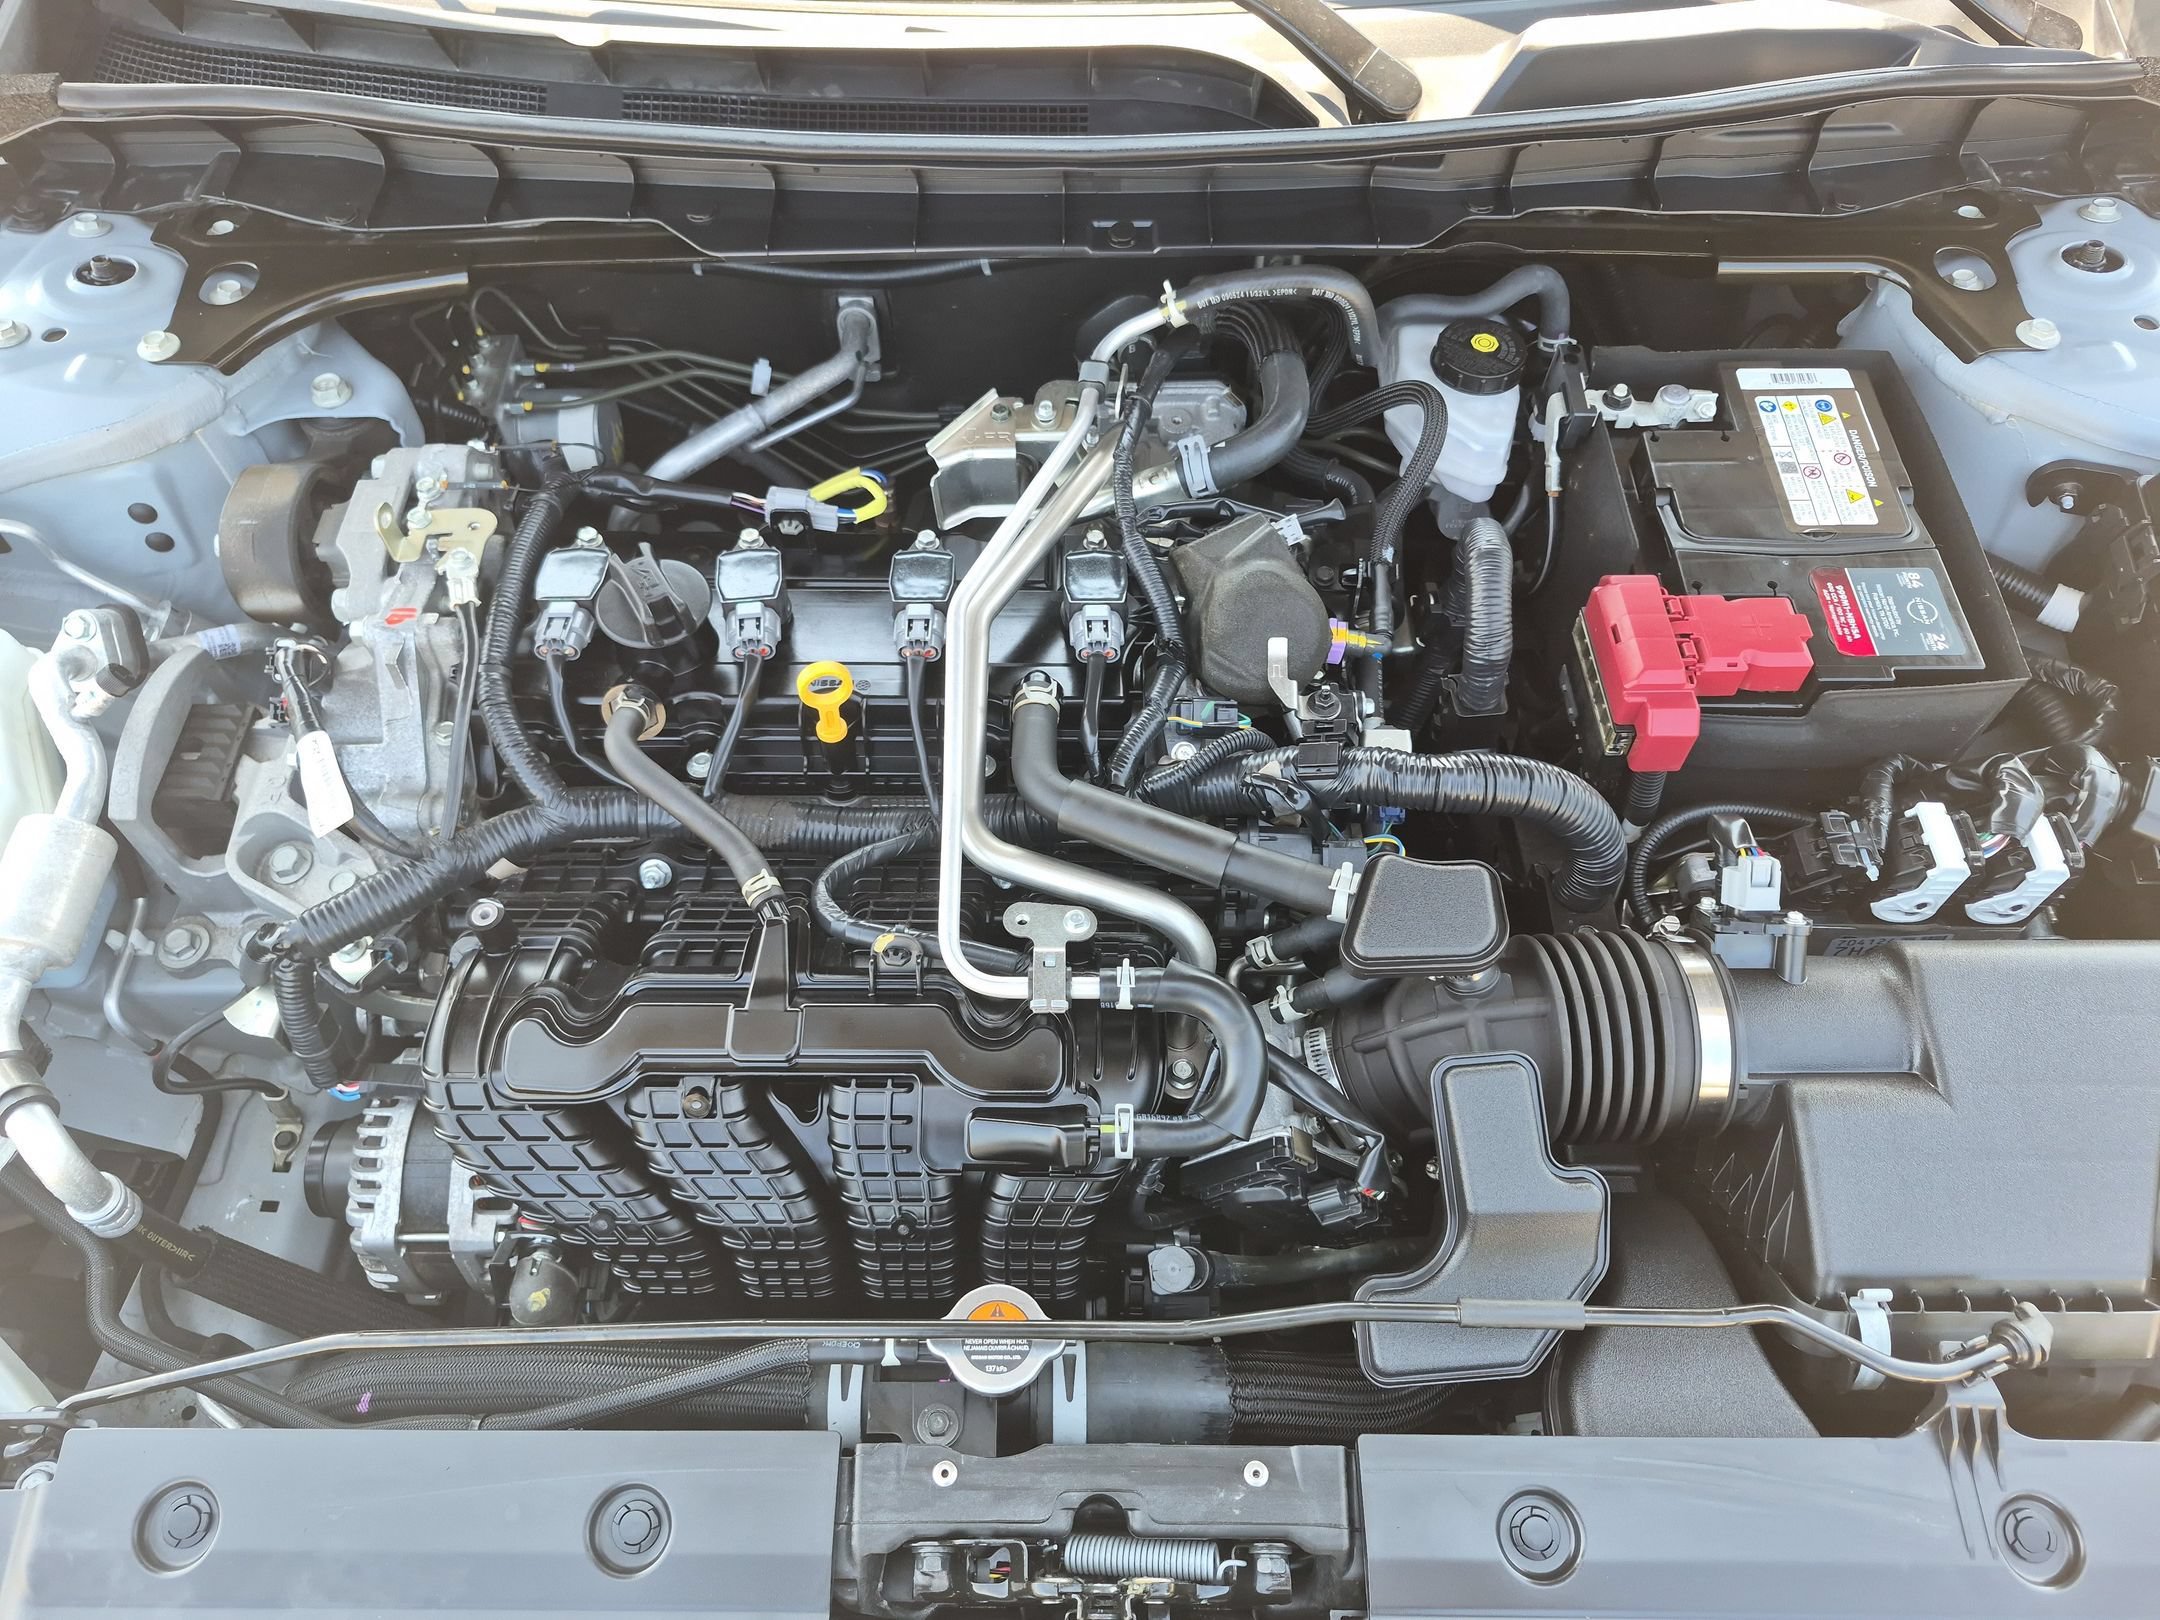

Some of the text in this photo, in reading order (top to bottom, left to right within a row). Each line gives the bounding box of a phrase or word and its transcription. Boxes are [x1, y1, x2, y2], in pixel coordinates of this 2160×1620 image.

[1848, 429, 1878, 488] DANGER/POISON
[1908, 573, 1924, 588] 84
[1915, 597, 1931, 625] NISSAN
[1932, 634, 1949, 650] 24
